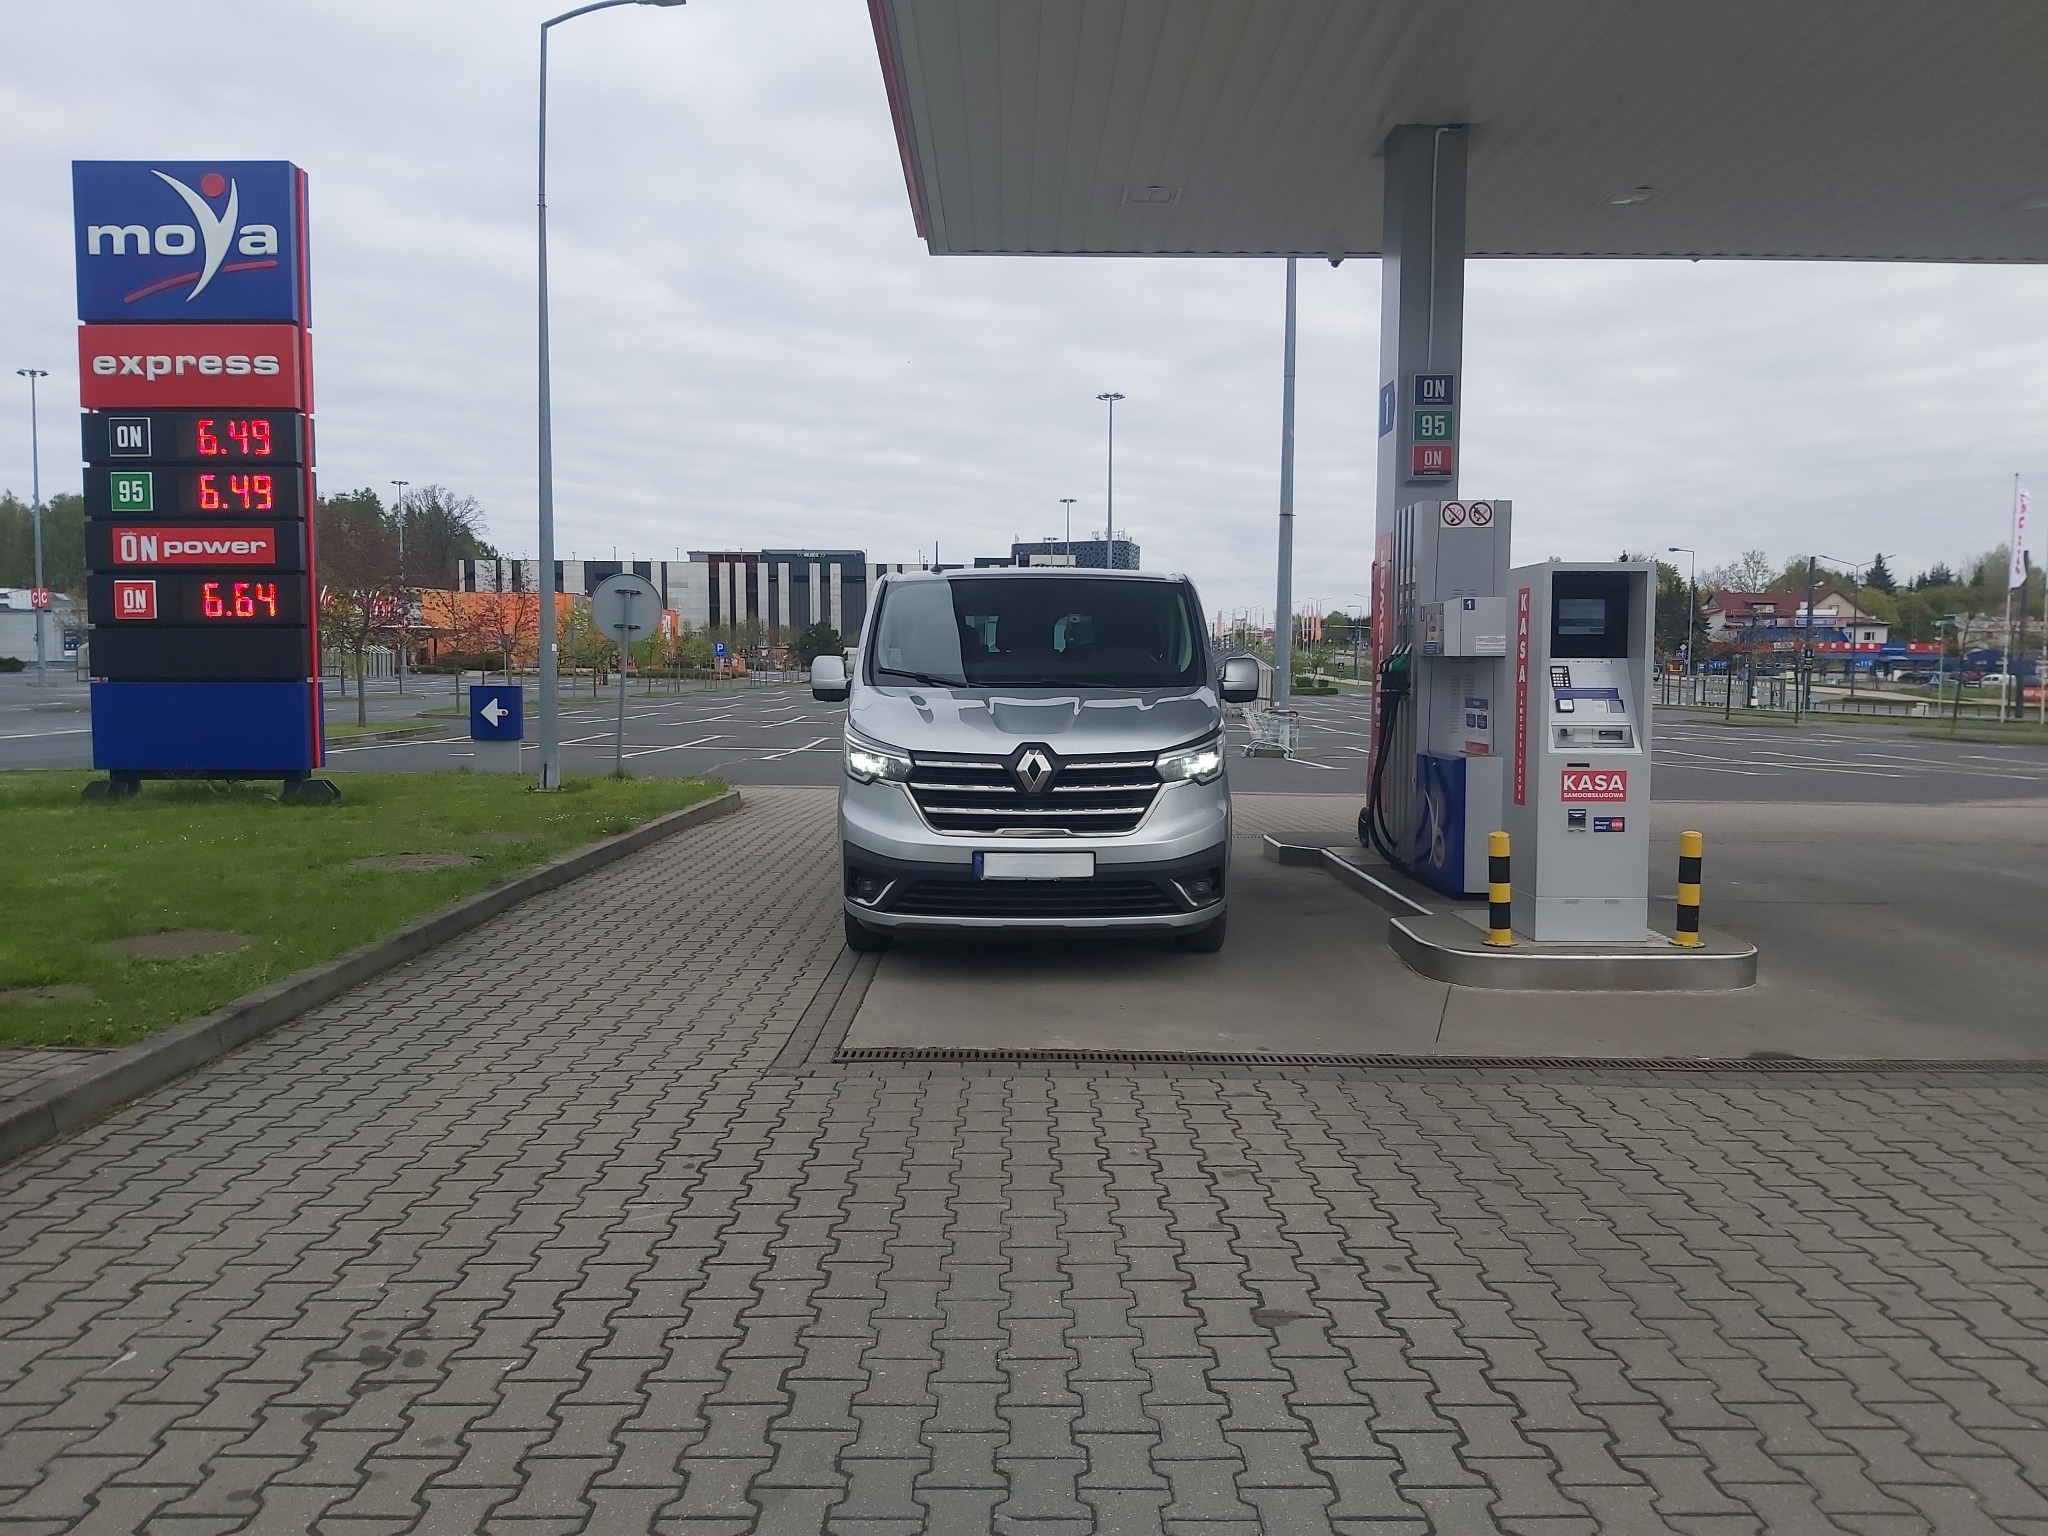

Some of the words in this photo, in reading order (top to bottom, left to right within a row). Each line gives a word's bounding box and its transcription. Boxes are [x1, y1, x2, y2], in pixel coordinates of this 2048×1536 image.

[92, 354, 280, 381] express
[1423, 379, 1446, 398] ON
[1384, 392, 1389, 426] 1
[116, 425, 142, 448] ON
[198, 419, 272, 455] 6.49
[1421, 415, 1446, 437] 95
[1424, 450, 1443, 466] ON
[117, 480, 144, 502] 95
[199, 474, 273, 510] 6.49
[120, 535, 158, 562] ON
[163, 540, 267, 558] power
[123, 589, 147, 609] ON
[203, 582, 277, 618] 6.64
[1466, 600, 1473, 609] 1
[716, 643, 724, 653] P
[1518, 594, 1527, 682] KASA
[1563, 774, 1624, 791] KASA
